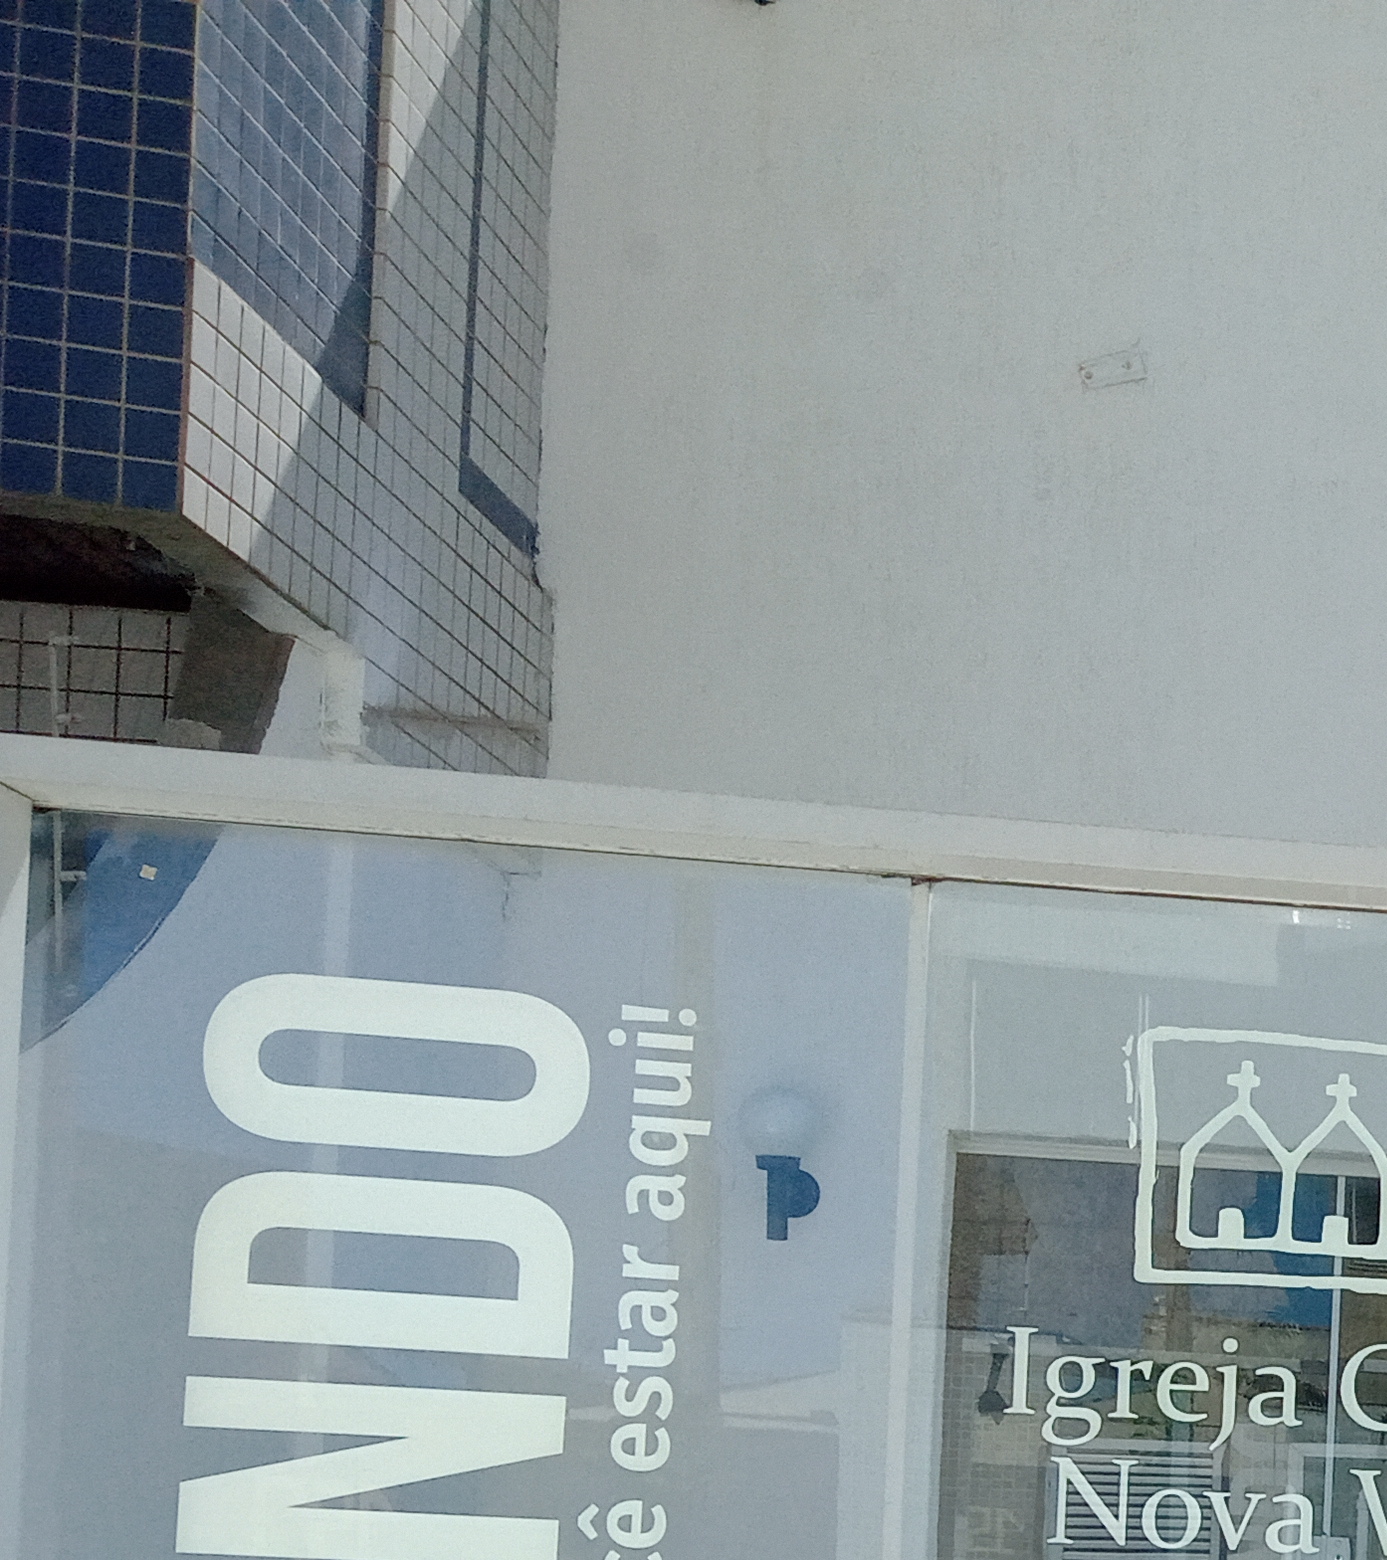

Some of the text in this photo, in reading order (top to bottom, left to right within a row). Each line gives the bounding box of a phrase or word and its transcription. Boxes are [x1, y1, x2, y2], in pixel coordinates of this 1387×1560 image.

[608, 1004, 711, 1166] aqui!
[625, 1174, 687, 1221] a
[604, 1244, 680, 1471] estar
[1001, 1325, 1304, 1452] Igreja
[1046, 1456, 1321, 1555] Nova
